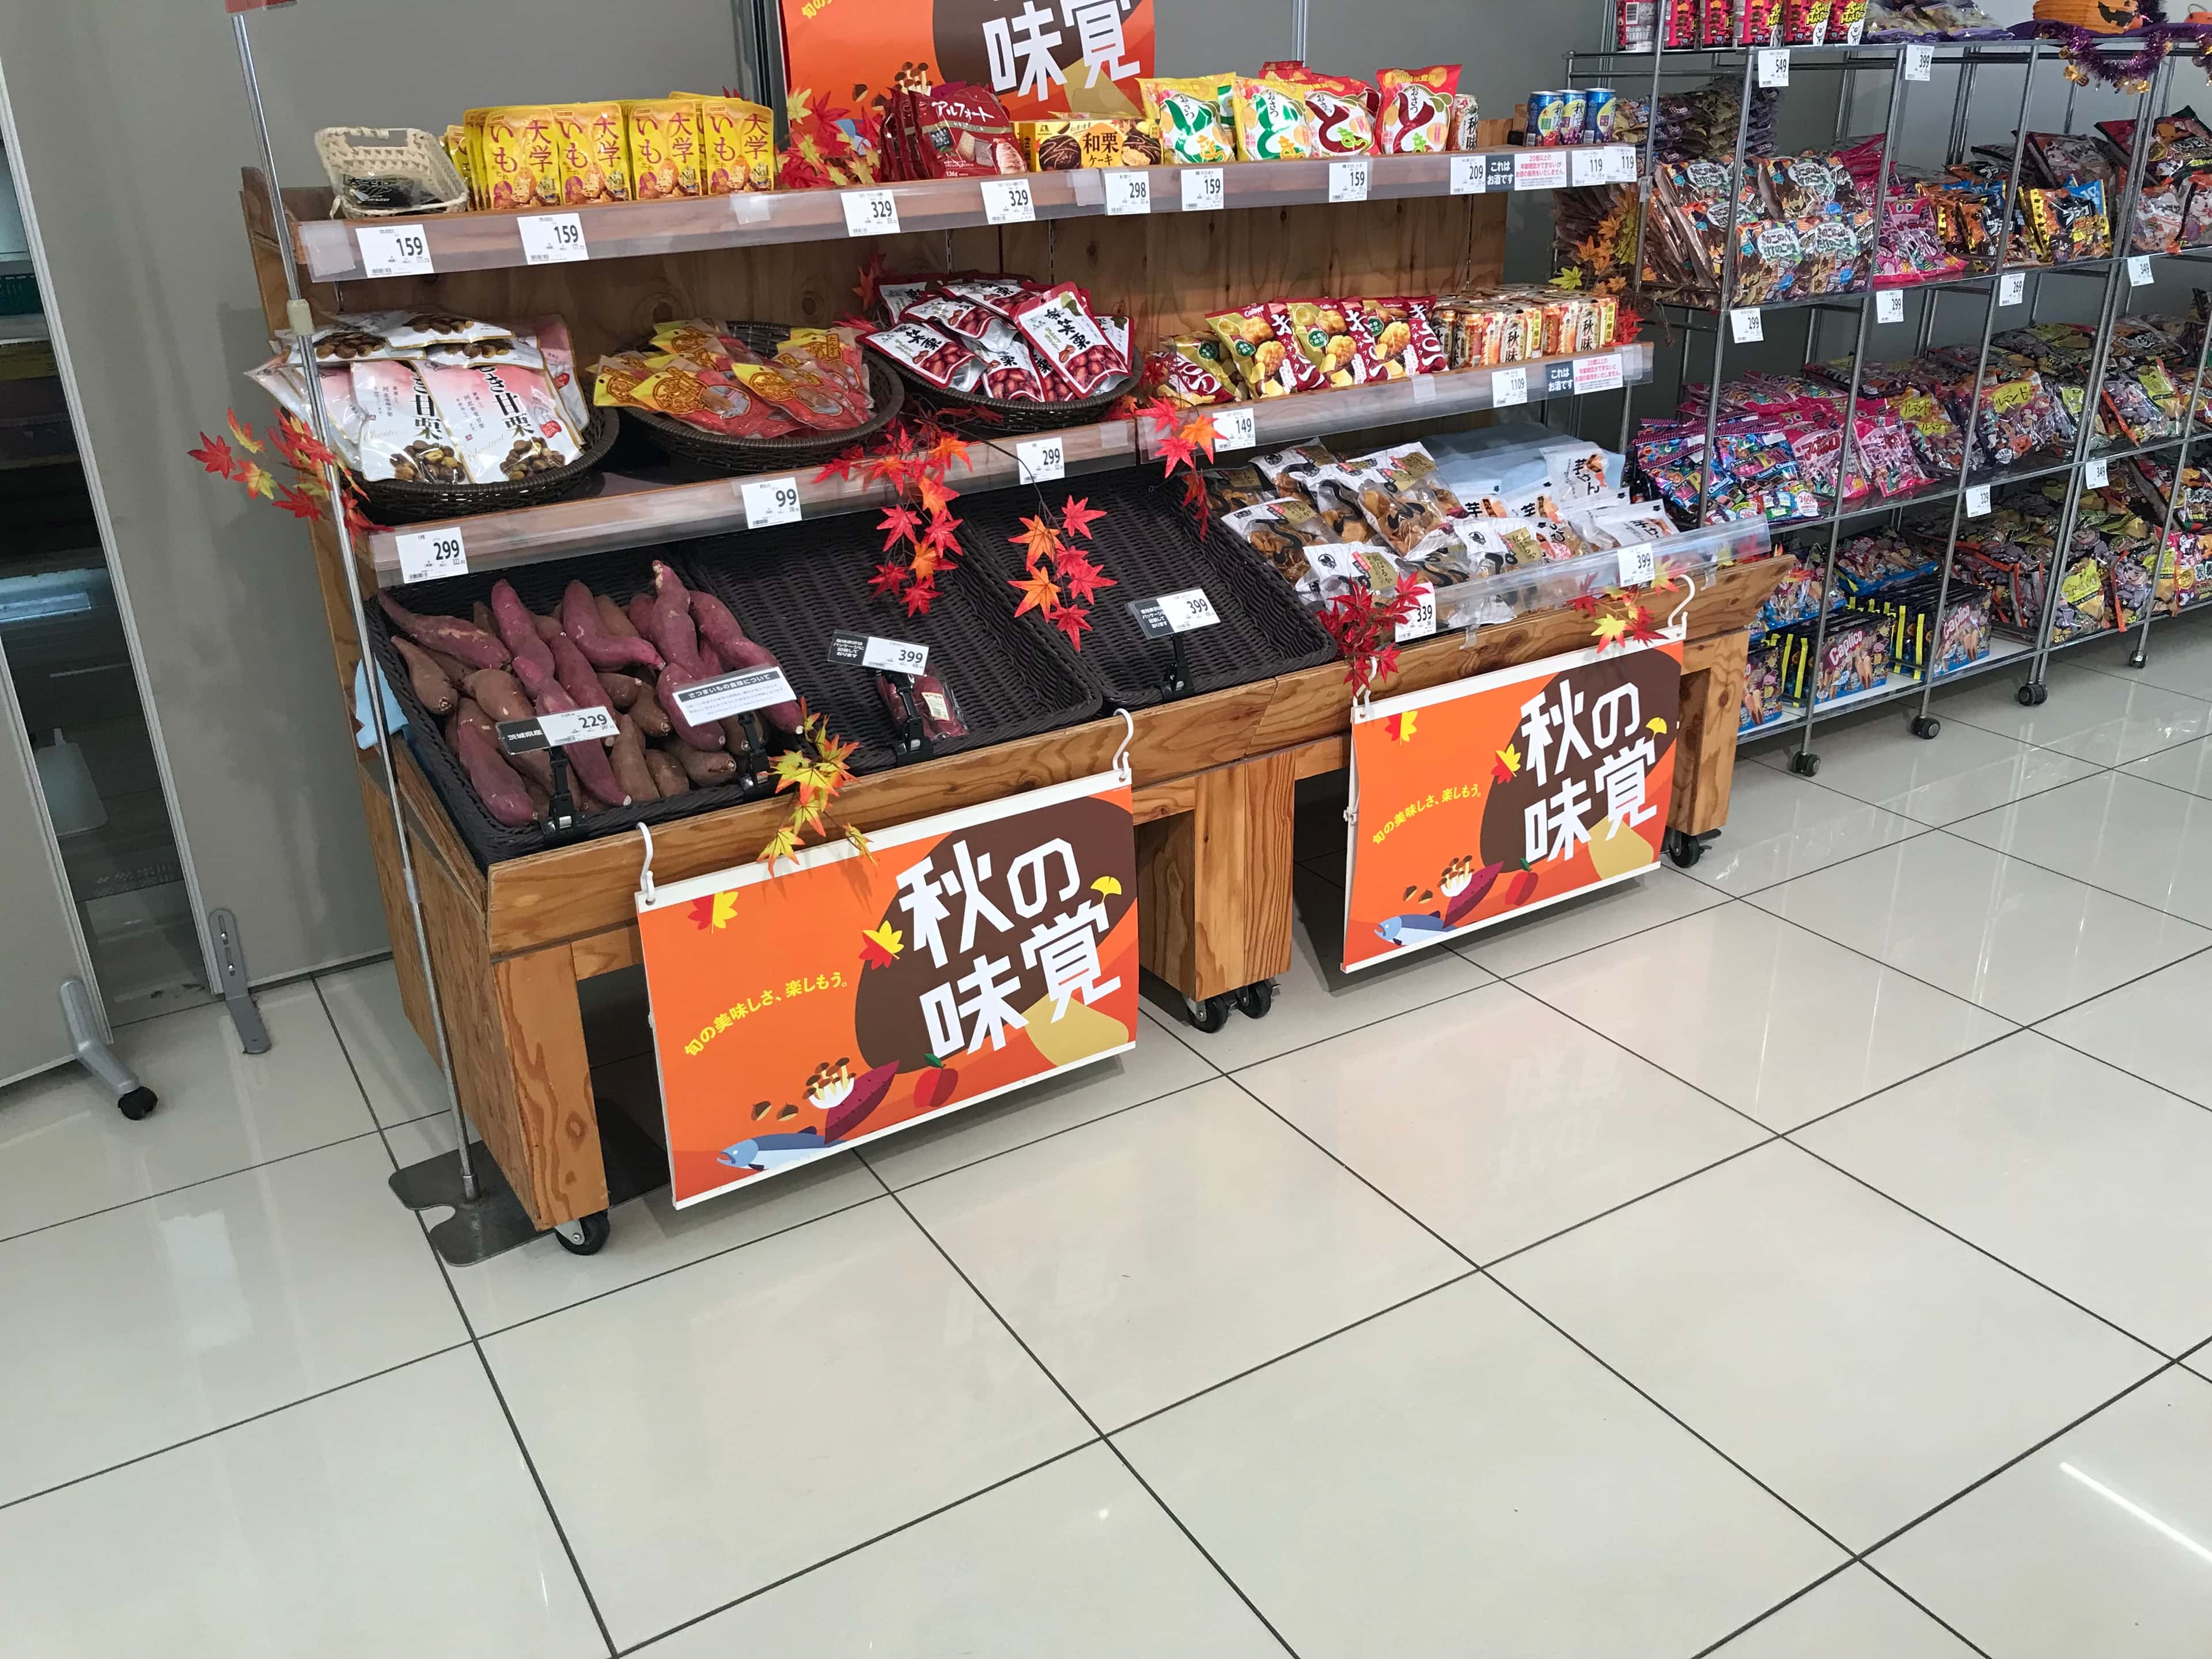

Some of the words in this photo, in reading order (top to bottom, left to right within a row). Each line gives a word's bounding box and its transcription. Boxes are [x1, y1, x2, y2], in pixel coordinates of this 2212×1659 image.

[982, 0, 1141, 101] 味覚
[1775, 58, 1787, 73] 549
[1919, 55, 1930, 68] 399
[1268, 92, 1279, 118] おさつ
[1410, 87, 1419, 113] おさつ
[931, 101, 995, 123] アルフォート
[524, 119, 552, 173] 大学
[558, 122, 588, 168] いも
[592, 113, 621, 168] 大学
[636, 119, 662, 164] いも
[669, 112, 695, 164] 大学
[710, 116, 736, 161] いも
[744, 113, 769, 160] 大学
[1082, 131, 1120, 154] 和栗
[490, 126, 518, 173] いも
[1088, 154, 1113, 167] ケーキ
[1491, 161, 1510, 172] これは
[1590, 158, 1603, 173] 119
[1622, 156, 1634, 169] 119
[1350, 171, 1365, 187] 159
[1469, 165, 1483, 180] 209
[1487, 174, 1513, 185] お酒です
[1129, 182, 1146, 198] 298
[1205, 179, 1221, 194] 159
[1009, 190, 1029, 207] 329
[871, 200, 892, 218] 329
[554, 225, 579, 244] 159
[396, 237, 423, 257] 159
[1892, 298, 1902, 310] 299
[1748, 317, 1759, 329] 299
[1411, 323, 1423, 357] スナック
[1581, 319, 1594, 350] 秋味
[1505, 331, 1520, 362] 秋味
[1551, 368, 1570, 379] これは
[1511, 378, 1524, 391] 1109
[1548, 380, 1573, 392] お酒です
[1235, 418, 1252, 434] 149
[1043, 448, 1060, 465] 299
[775, 488, 797, 507] 99
[433, 539, 460, 561] 299
[1637, 553, 1651, 569] 399
[1187, 599, 1209, 614] 399
[1417, 604, 1433, 622] 339
[1942, 604, 1971, 639] Caplico
[899, 649, 923, 663] 399
[1828, 630, 1863, 666] Caplico
[688, 673, 771, 698] さつまいもの食味について
[578, 714, 608, 729] 229
[1521, 680, 1641, 787] 秋の
[1524, 738, 1657, 863] 味覚
[1372, 783, 1482, 845] 旬の美味しさ、楽しもう。
[895, 838, 1081, 968] 秋の
[919, 899, 1121, 1060] 味覚
[684, 971, 848, 1058] 旬の美味しさ、楽しもう。
